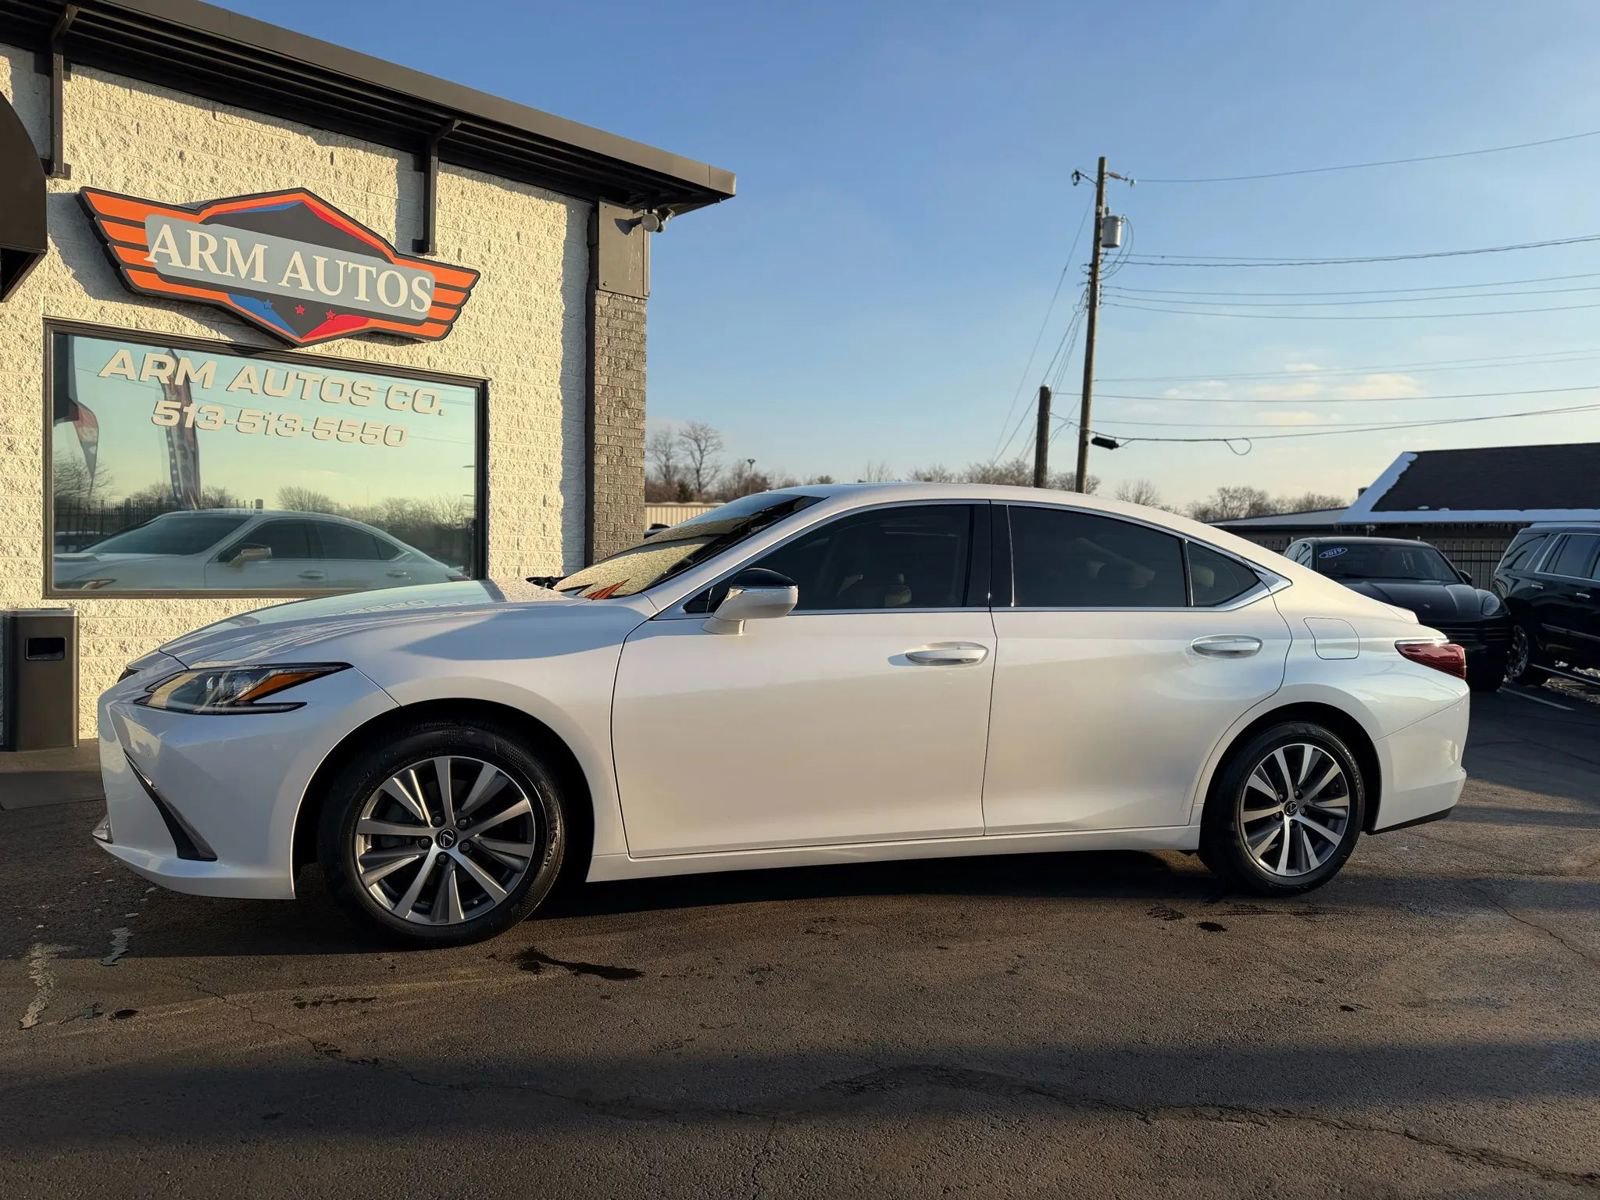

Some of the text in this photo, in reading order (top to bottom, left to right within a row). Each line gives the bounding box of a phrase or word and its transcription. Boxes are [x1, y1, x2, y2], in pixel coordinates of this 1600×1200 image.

[144, 223, 434, 313] ARM AUTOS
[97, 348, 445, 416] ARM AUTOS CO.
[151, 401, 408, 447] 513-513-5550
